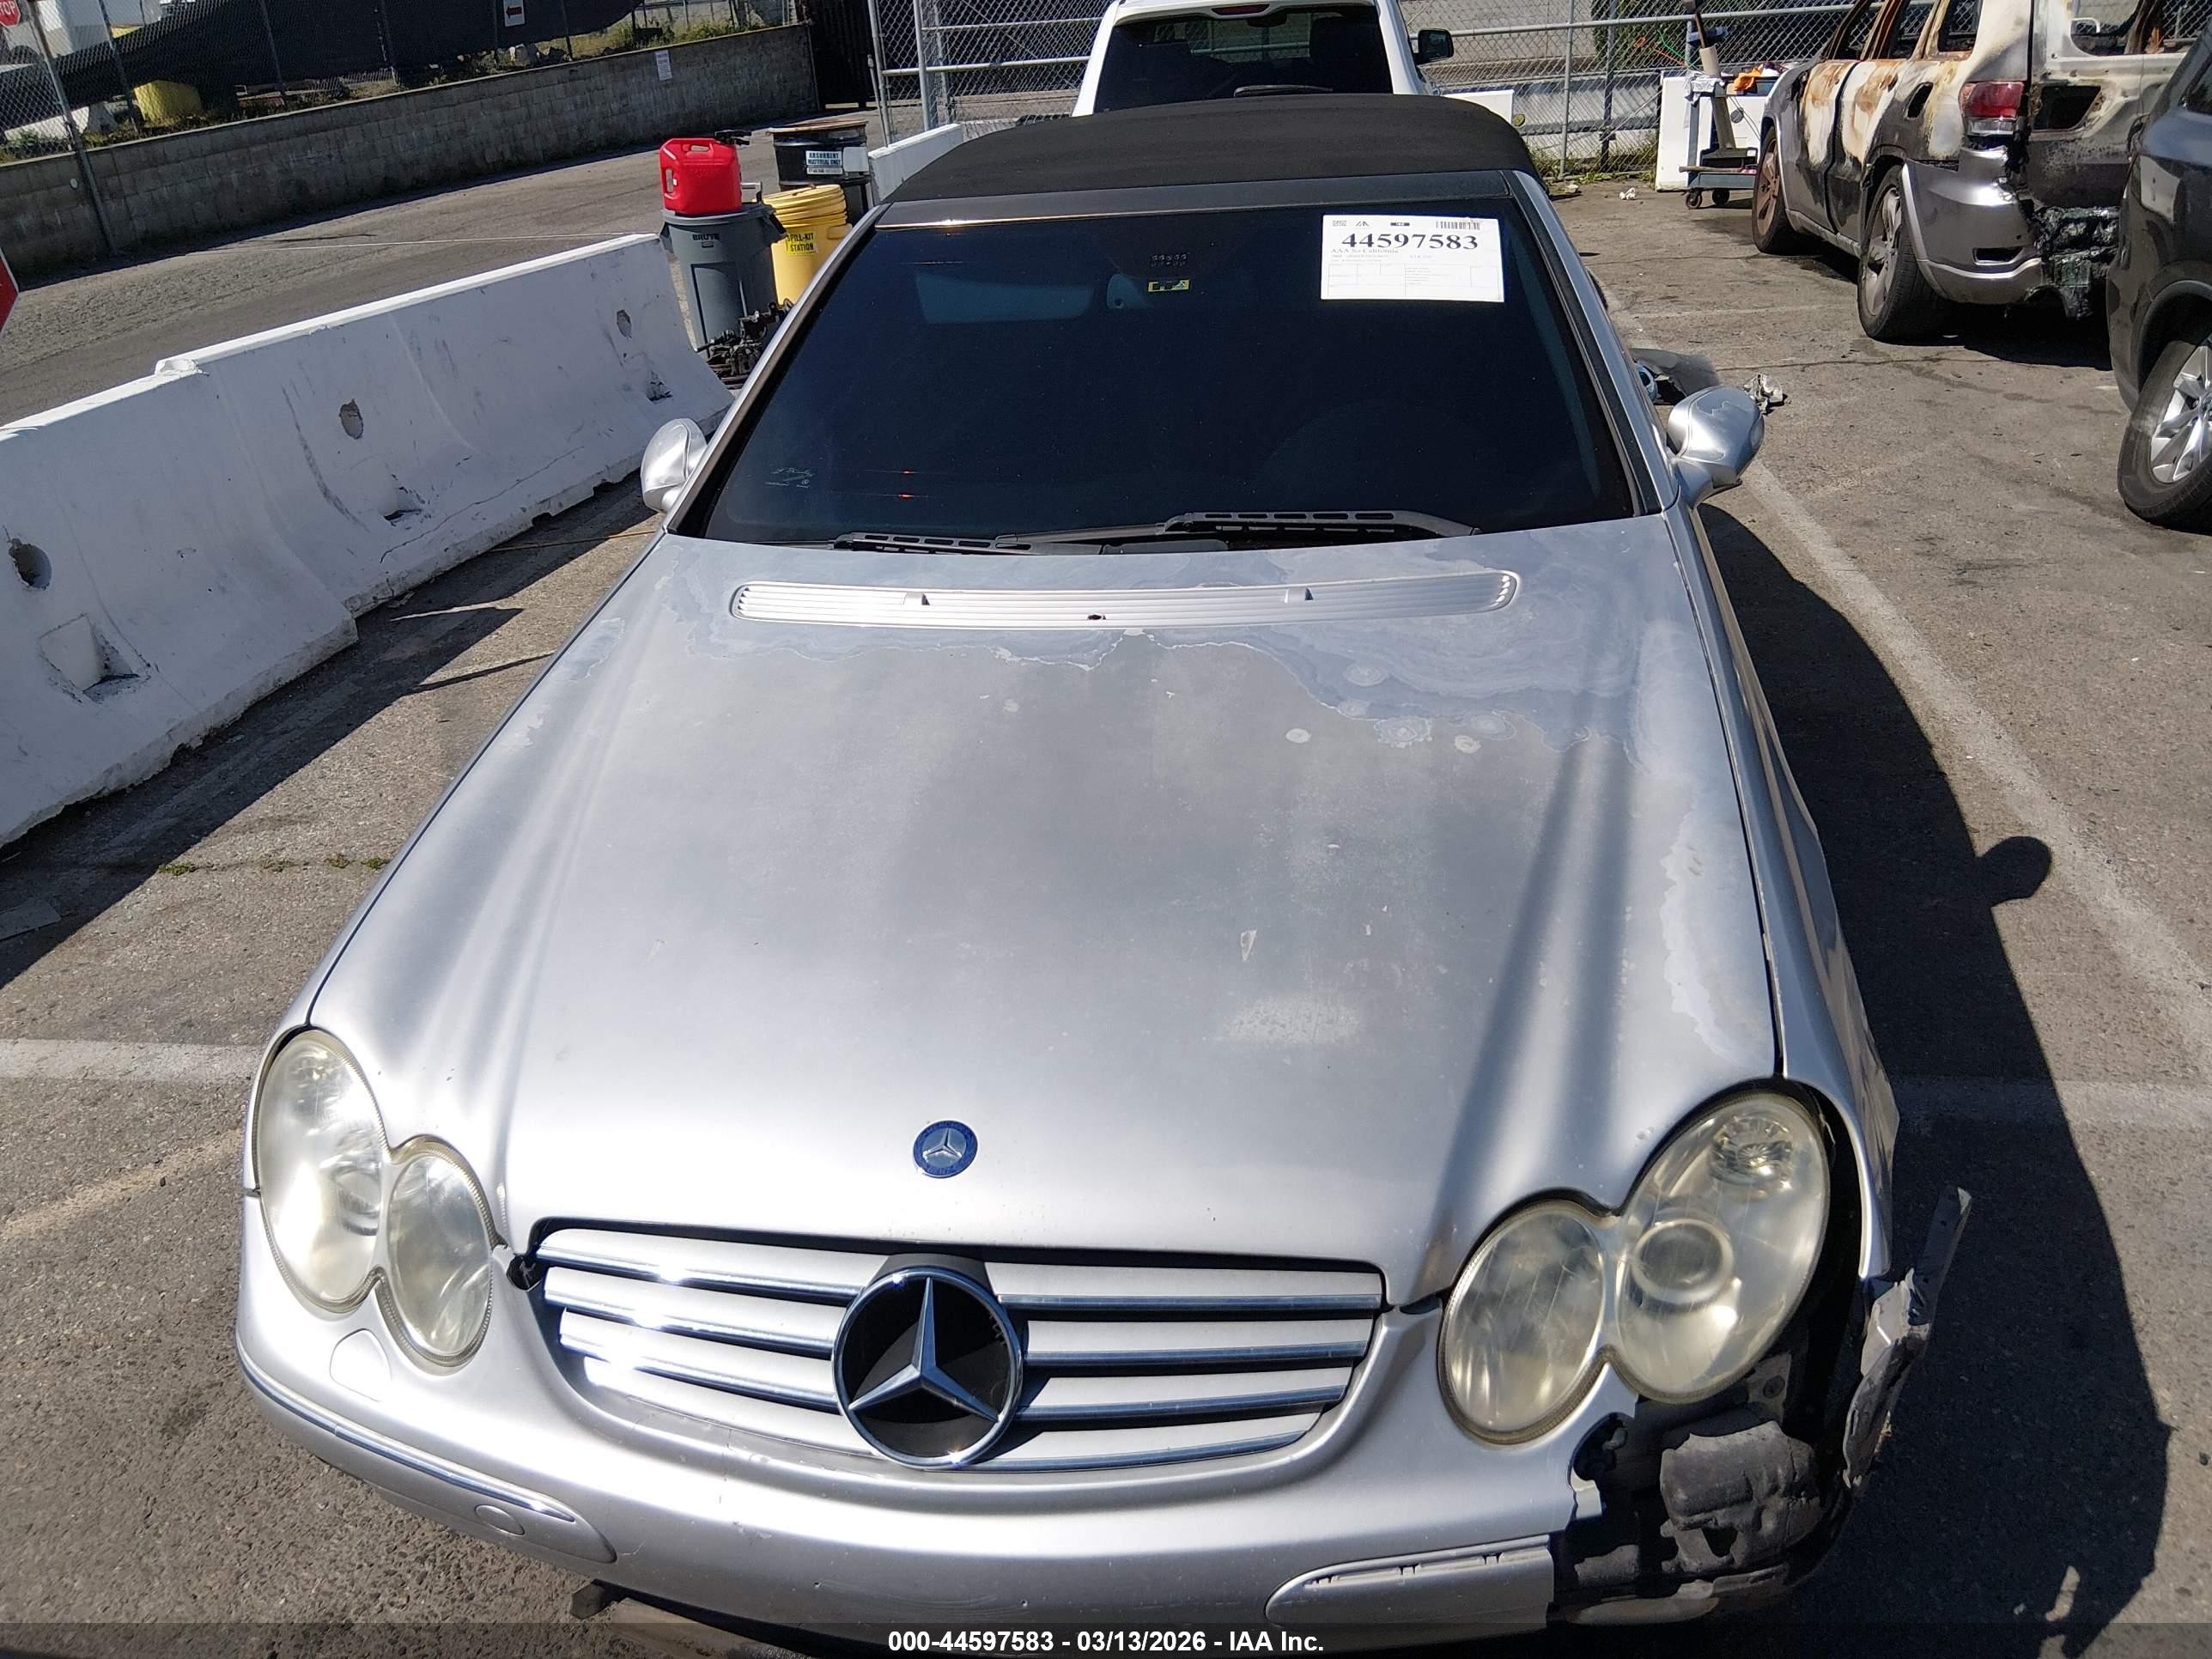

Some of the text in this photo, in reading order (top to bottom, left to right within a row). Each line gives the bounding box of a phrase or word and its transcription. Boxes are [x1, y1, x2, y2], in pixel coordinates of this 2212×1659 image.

[786, 232, 814, 242] SPILL-KIT
[1341, 233, 1479, 250] 44597583
[790, 242, 814, 252] STATION
